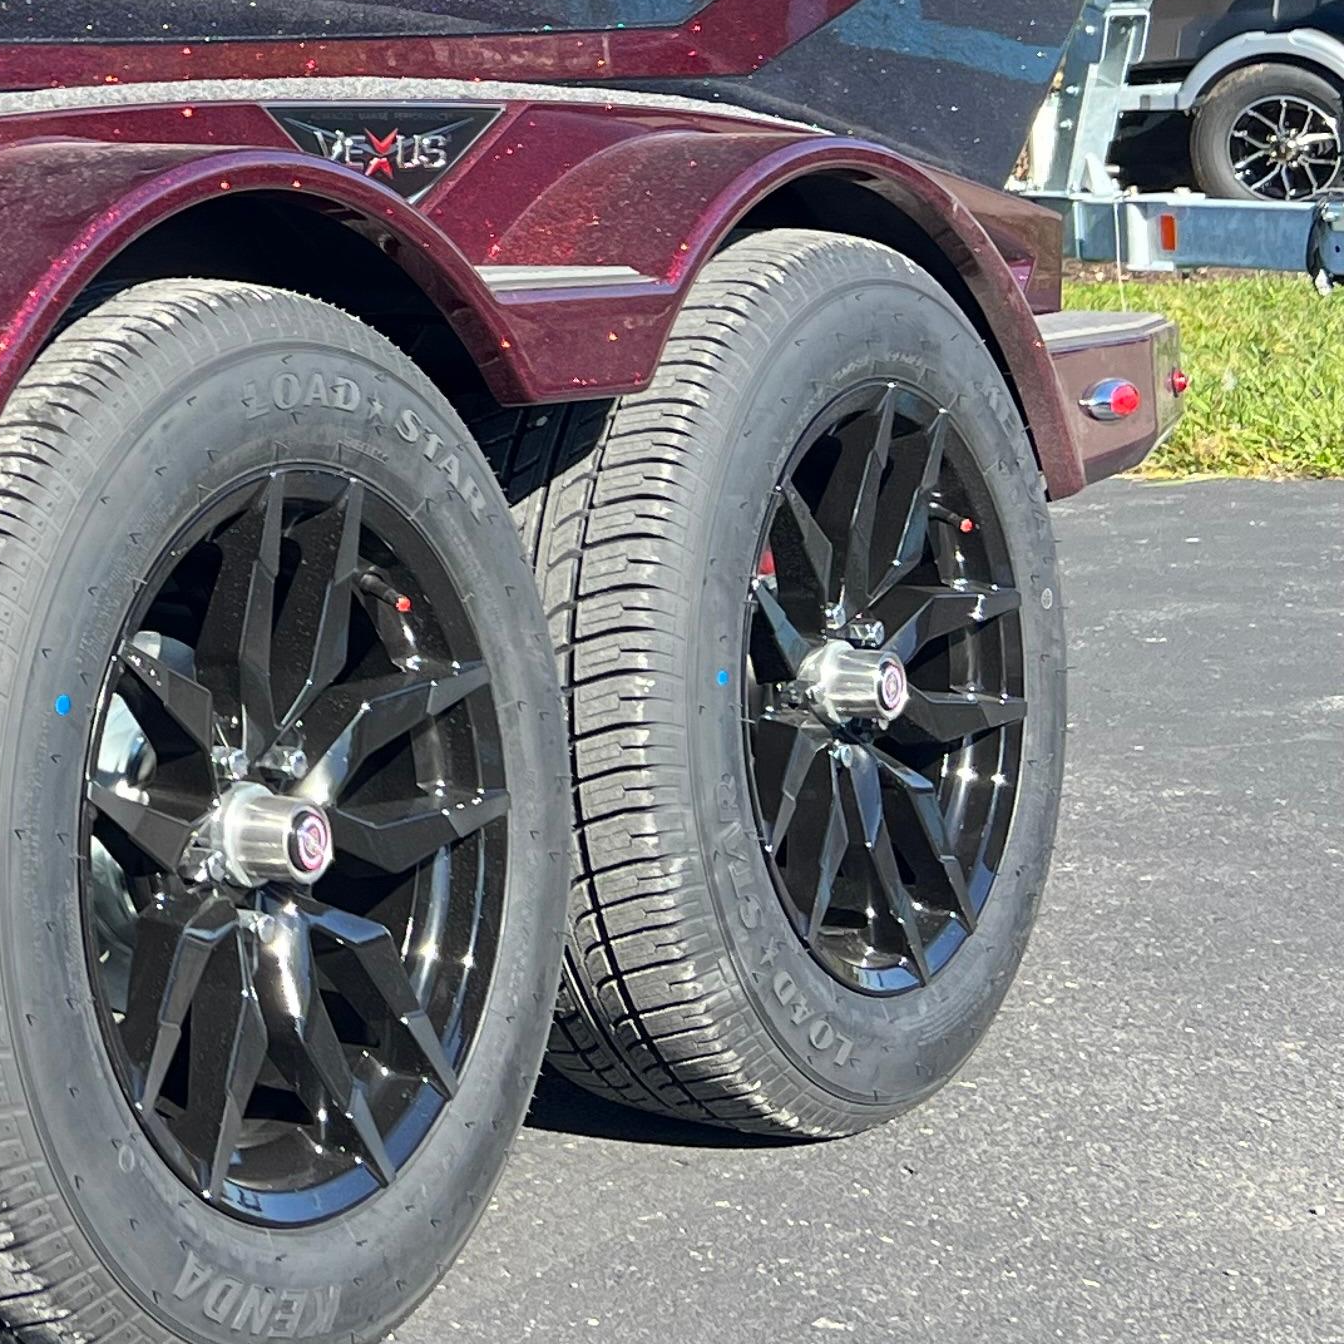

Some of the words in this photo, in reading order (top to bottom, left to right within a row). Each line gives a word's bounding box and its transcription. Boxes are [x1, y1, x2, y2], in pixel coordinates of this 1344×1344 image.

[313, 127, 449, 179] VEXUS
[242, 371, 361, 420] LOAD
[395, 408, 489, 525] STAR
[773, 969, 854, 1067] LOAD
[173, 1249, 343, 1340] KENDA
